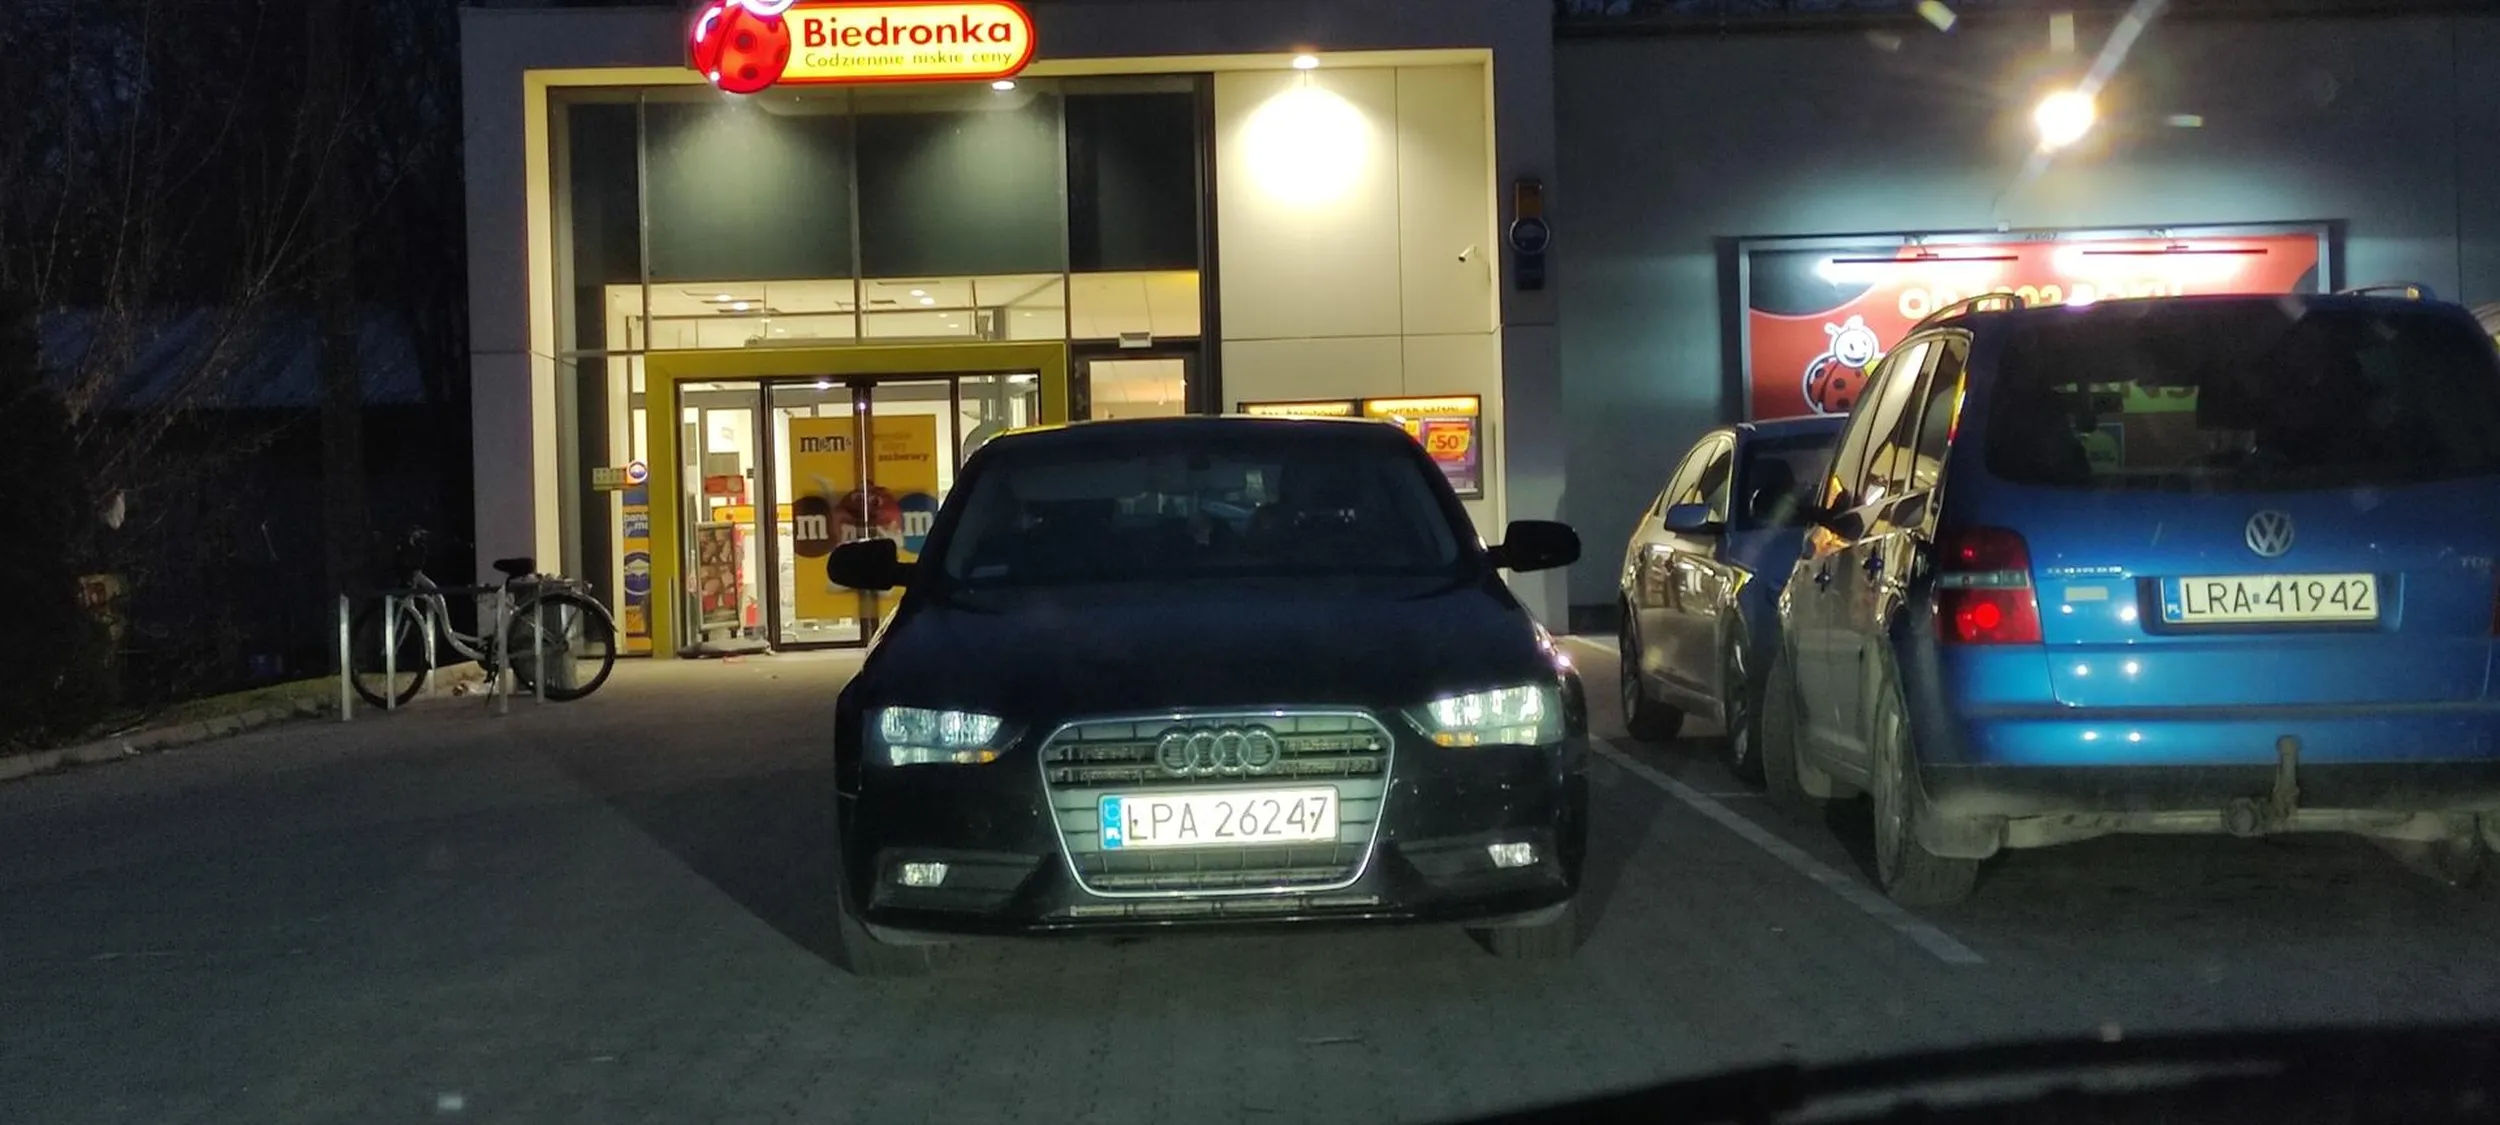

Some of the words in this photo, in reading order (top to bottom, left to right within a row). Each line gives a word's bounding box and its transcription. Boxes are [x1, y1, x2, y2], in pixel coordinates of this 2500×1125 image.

[803, 14, 1012, 48] Biedronka
[805, 52, 904, 68] Codziennie
[913, 50, 964, 64] niskie
[972, 51, 1012, 66] ceny
[2186, 581, 2252, 614] LRA
[2265, 580, 2372, 613] 41942
[1127, 801, 1199, 841] LPA
[1214, 796, 1329, 838] 26247
